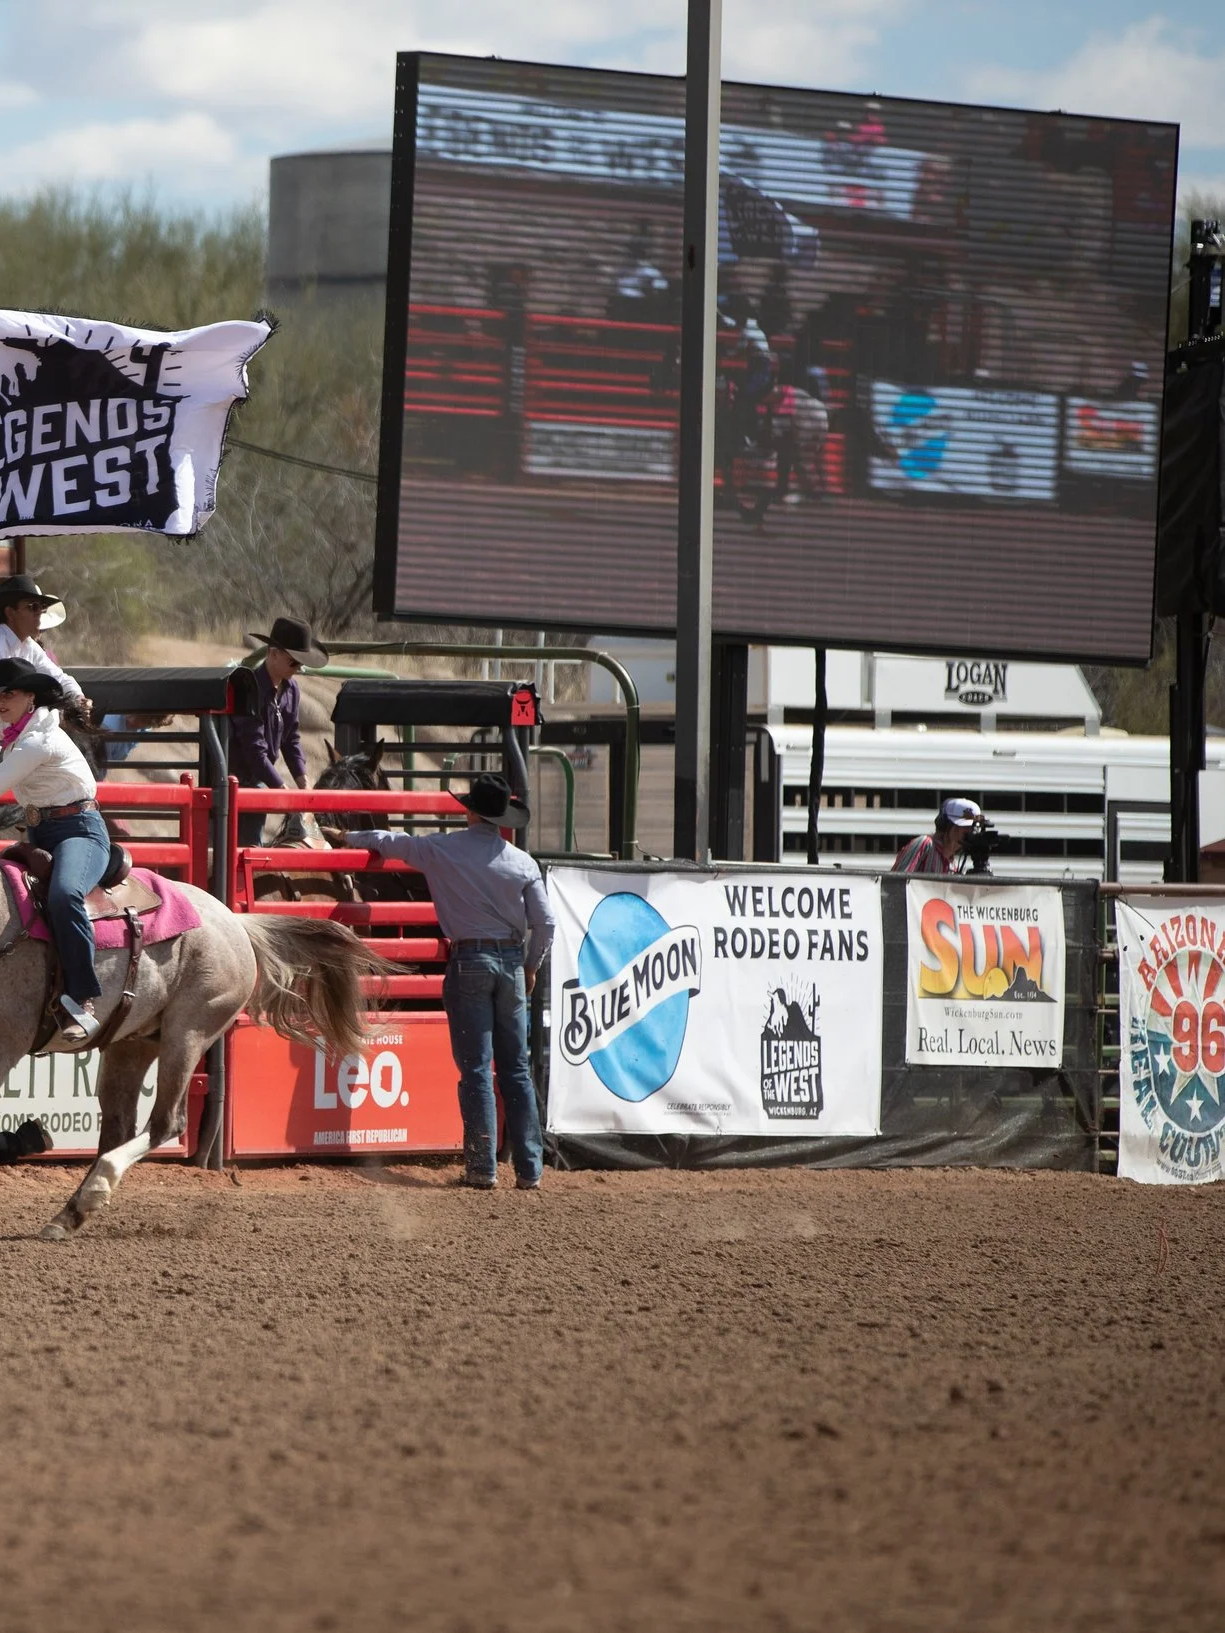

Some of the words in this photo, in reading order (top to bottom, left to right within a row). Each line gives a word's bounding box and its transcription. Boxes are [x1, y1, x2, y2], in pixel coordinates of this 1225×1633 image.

[945, 661, 1008, 695] LOGAN
[724, 885, 853, 919] WELCOME
[957, 905, 974, 920] THE
[976, 905, 1039, 922] WICKENBURG
[713, 926, 800, 960] RODEO
[806, 928, 869, 962] FANS
[920, 897, 1043, 992] SUN
[564, 981, 630, 1055] BLUE
[631, 937, 698, 1010] MOON
[944, 1006, 1023, 1022] WickenburgSun.com
[377, 1035, 404, 1045] HOUSE
[918, 1027, 953, 1054] Real.
[958, 1028, 1005, 1056] Local.
[1009, 1030, 1057, 1057] News
[763, 1040, 819, 1074] LEGENDS
[763, 1078, 773, 1089] OF
[763, 1089, 775, 1101] THE
[773, 1067, 819, 1103] WEST
[40, 1112, 92, 1133] RODEO
[809, 1106, 818, 1116] AZ
[314, 1131, 345, 1145] AMERICA
[346, 1130, 366, 1144] FIRST
[366, 1128, 408, 1144] REPUBLICAN
